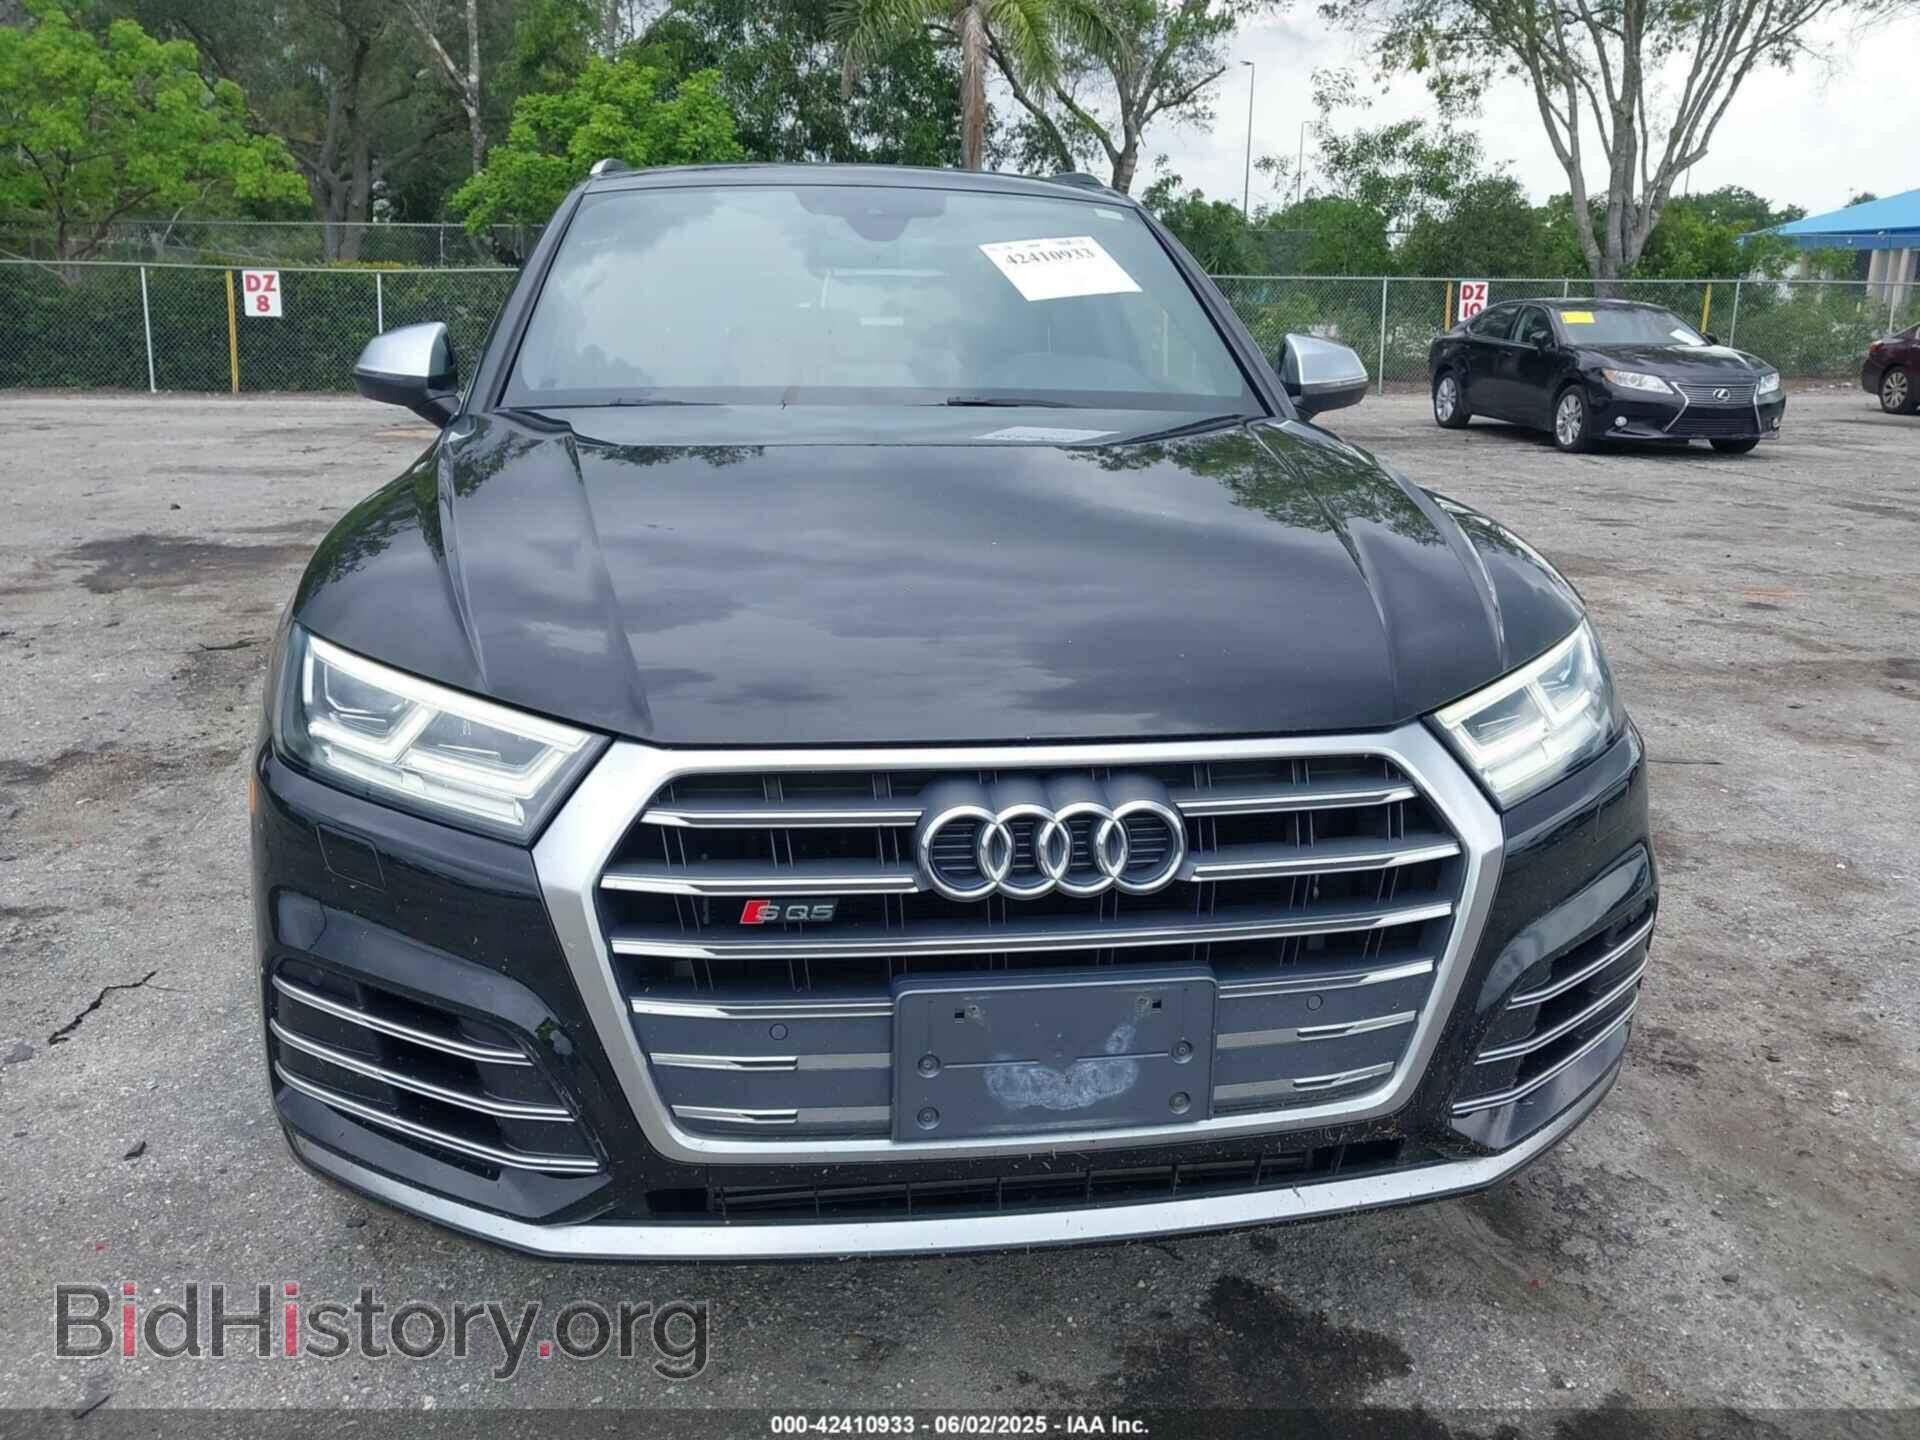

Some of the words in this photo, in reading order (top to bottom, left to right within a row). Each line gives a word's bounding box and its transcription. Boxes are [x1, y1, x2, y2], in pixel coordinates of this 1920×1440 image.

[1007, 248, 1095, 264] 42410933
[245, 274, 276, 292] DZ
[1462, 284, 1486, 300] DZ
[256, 294, 270, 312] 8
